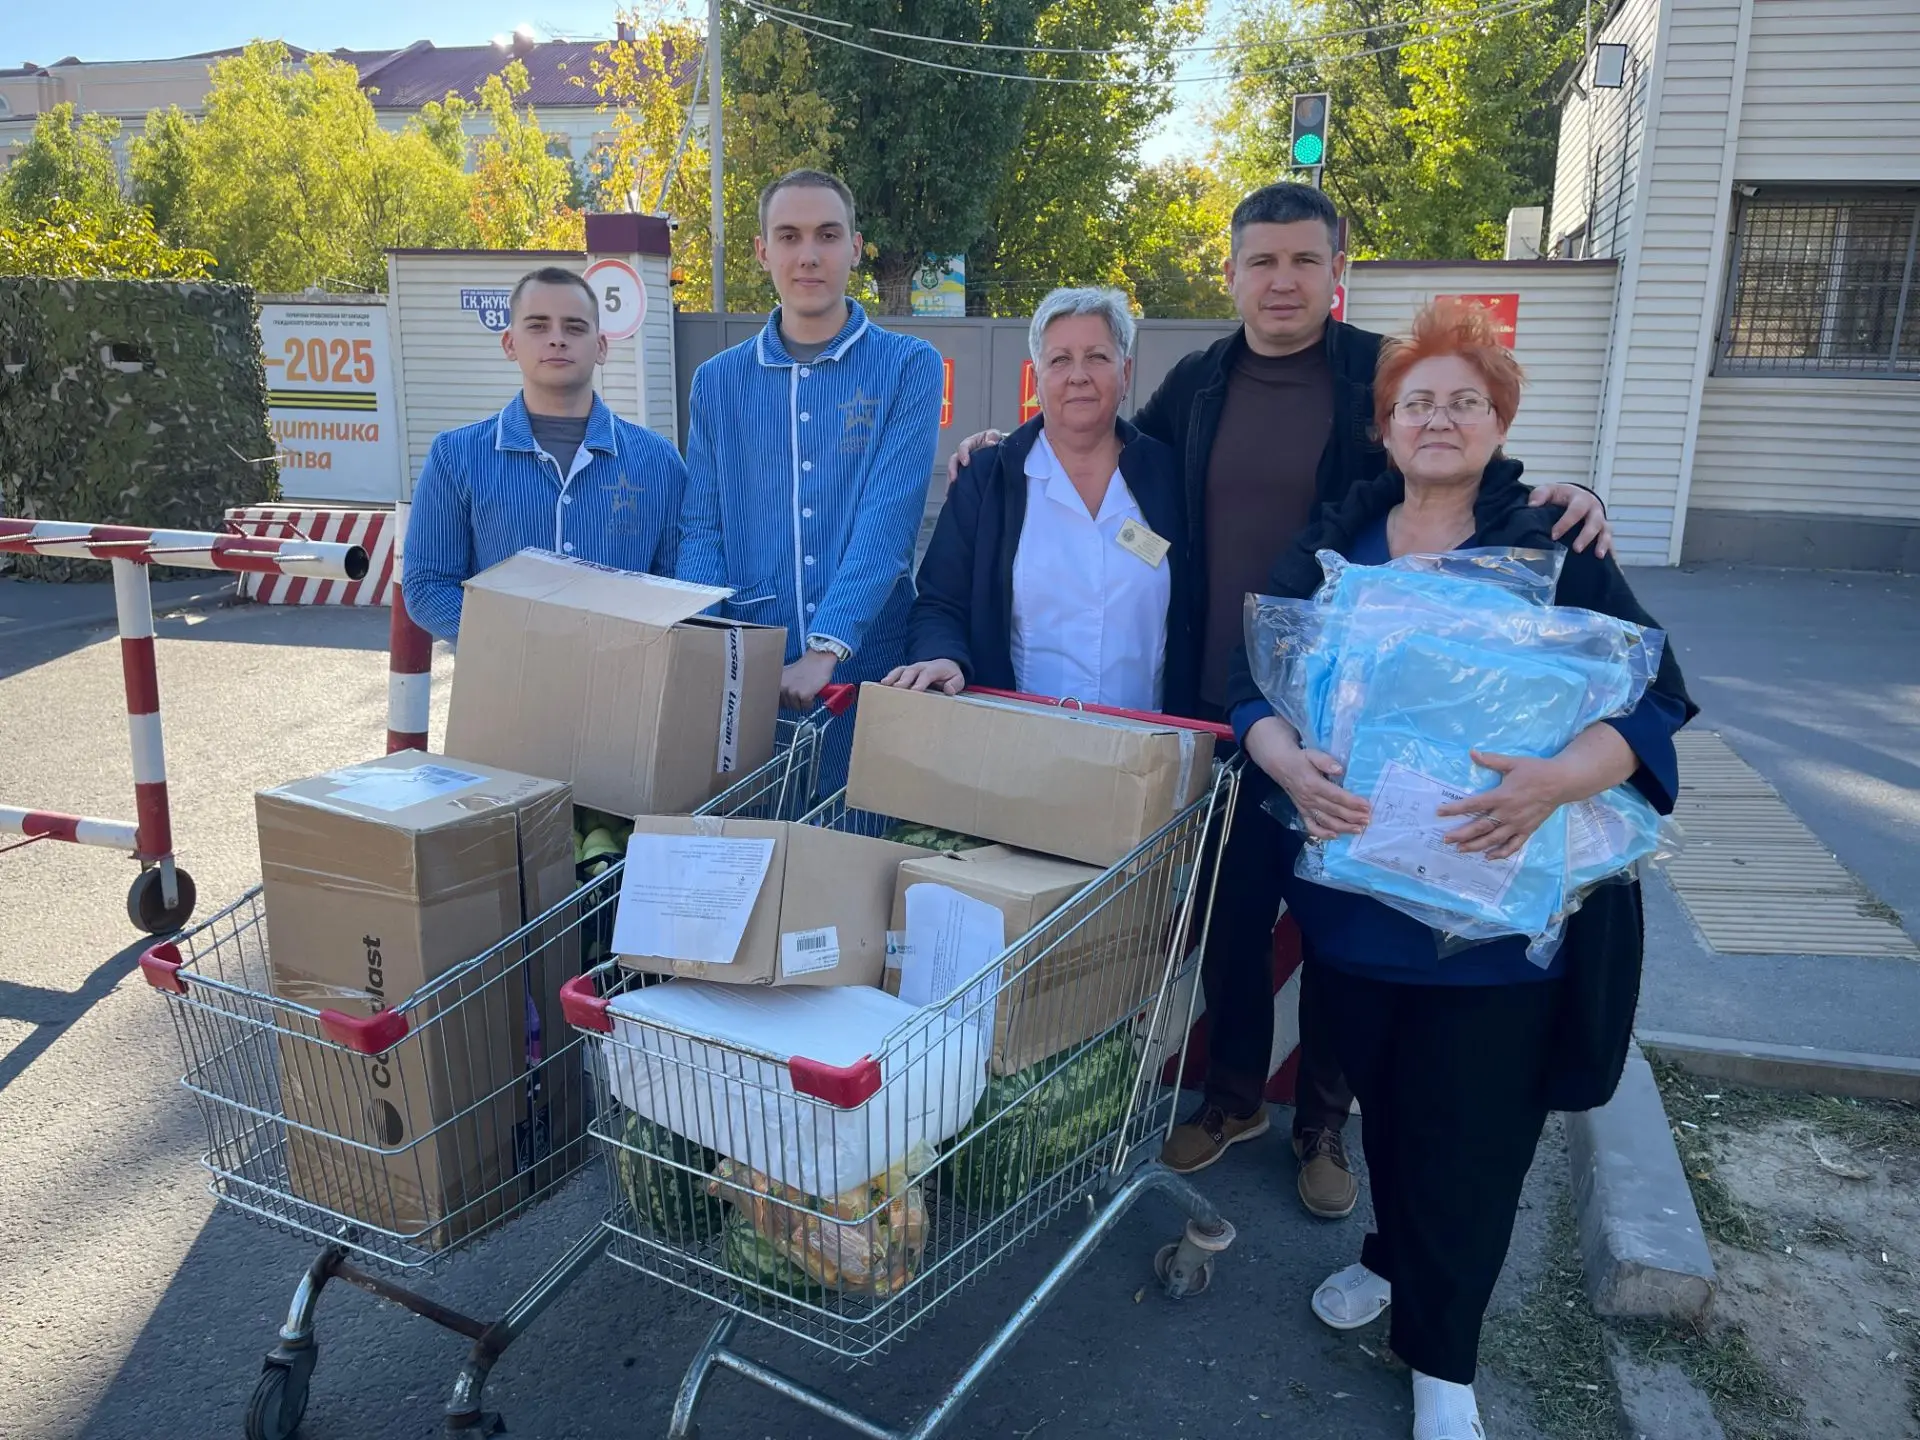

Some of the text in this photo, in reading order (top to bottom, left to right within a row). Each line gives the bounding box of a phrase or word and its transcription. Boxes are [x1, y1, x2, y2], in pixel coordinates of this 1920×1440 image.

[604, 286, 621, 312] 5
[485, 310, 507, 327] 81
[270, 420, 379, 443] щитника
[725, 690, 737, 746] Luxsan
